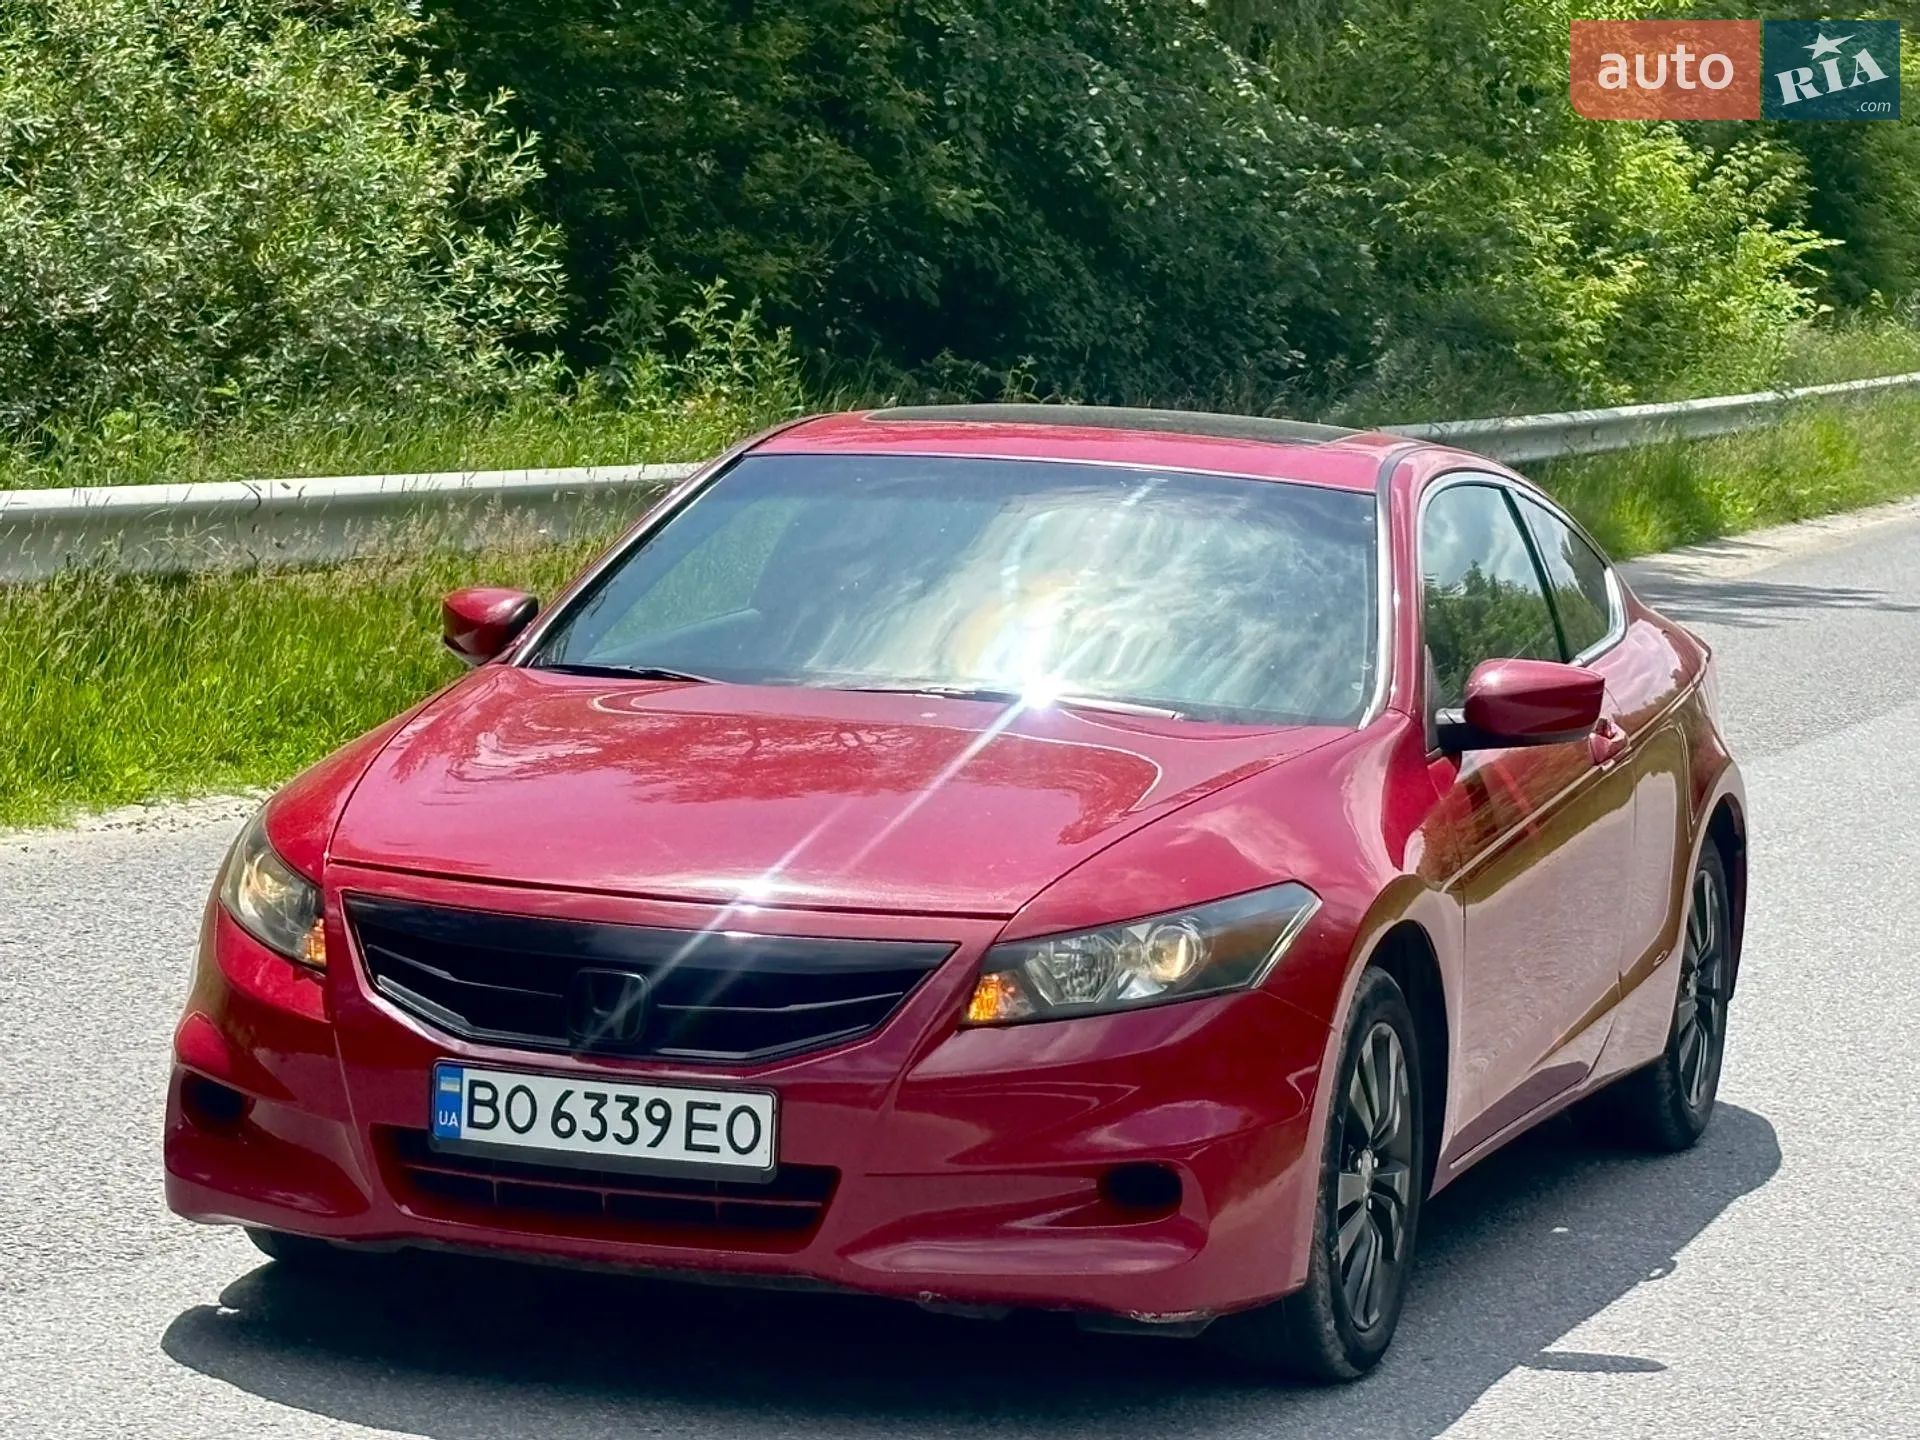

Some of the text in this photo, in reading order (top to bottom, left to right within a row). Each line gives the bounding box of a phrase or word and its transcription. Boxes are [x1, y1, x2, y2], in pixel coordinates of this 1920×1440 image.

[438, 1110, 459, 1127] UA
[467, 1079, 762, 1155] BO 6339 EO
